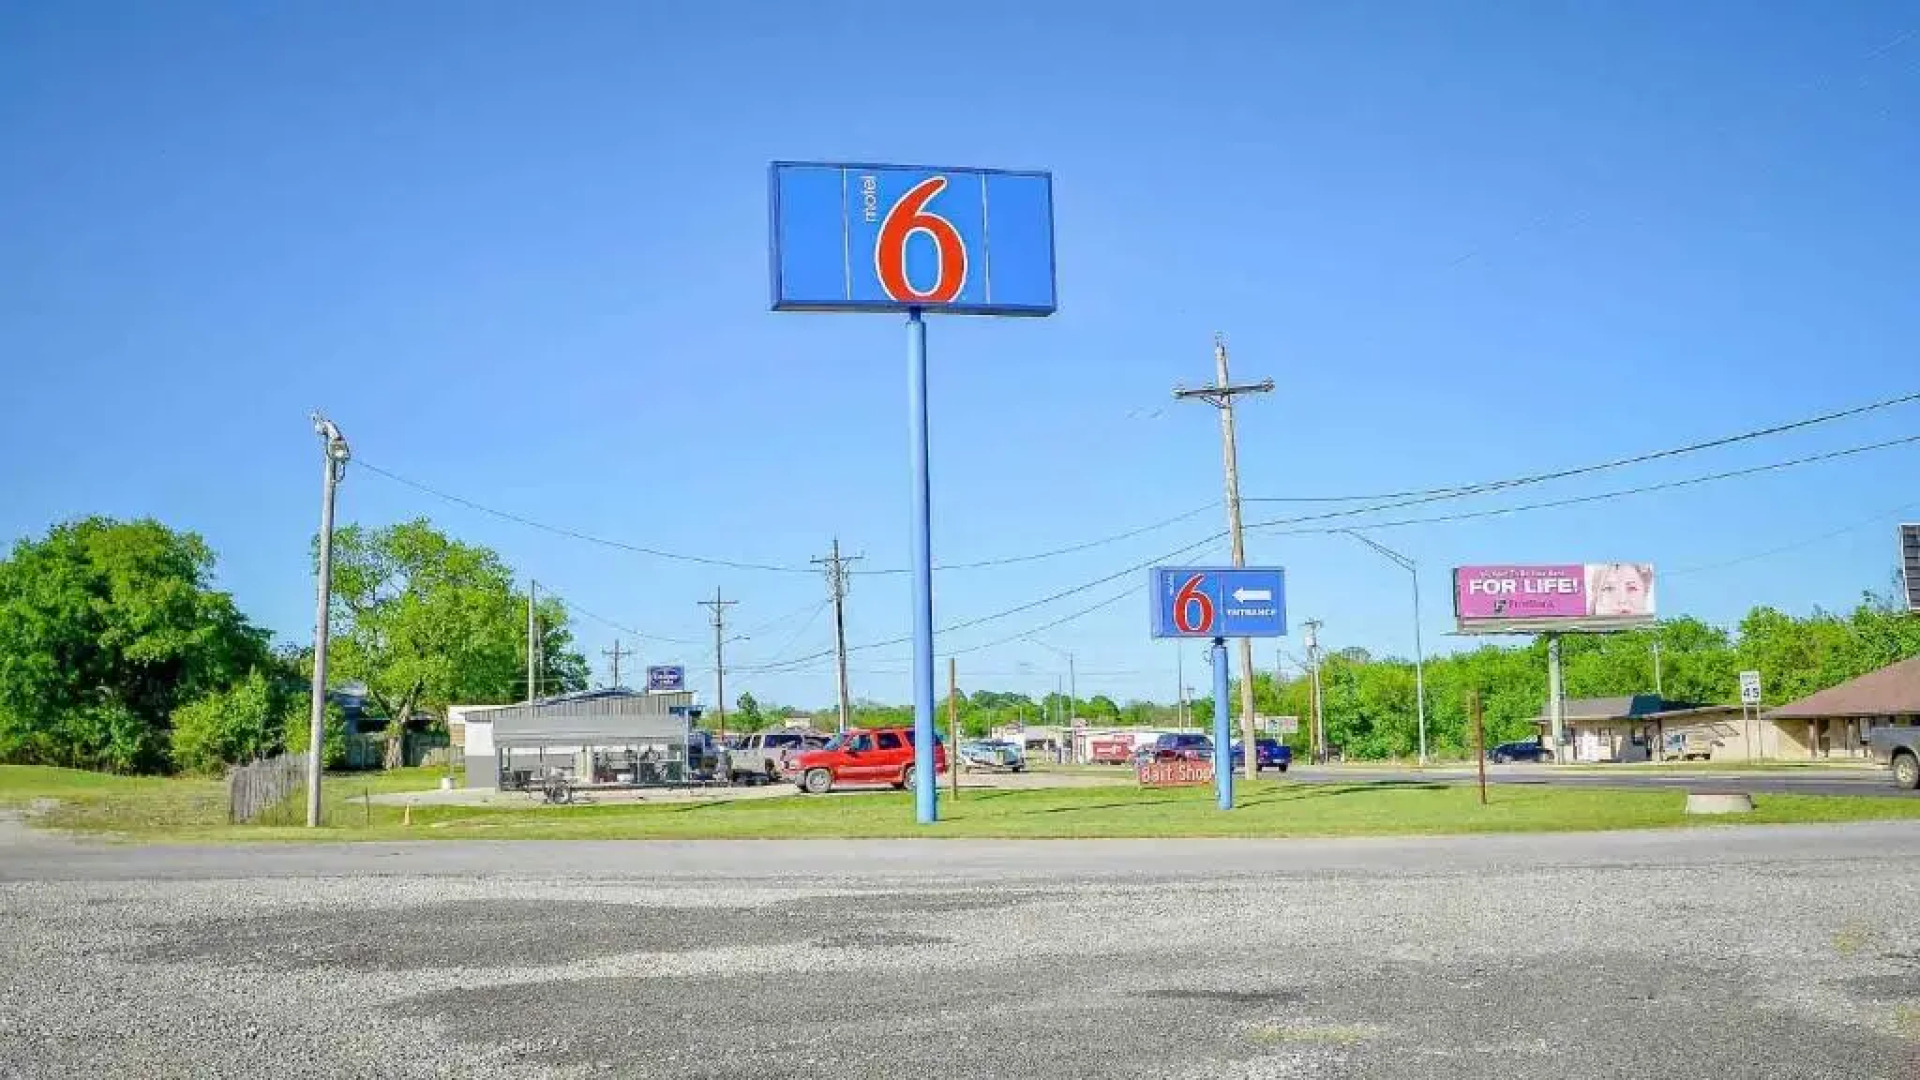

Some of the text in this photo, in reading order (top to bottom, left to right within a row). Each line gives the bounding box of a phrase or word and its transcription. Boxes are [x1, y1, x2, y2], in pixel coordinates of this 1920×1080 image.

[860, 175, 877, 223] motel
[874, 176, 968, 303] 6
[1173, 573, 1214, 635] 6
[1469, 576, 1578, 595] FOR LIFE!
[1743, 687, 1760, 698] 45
